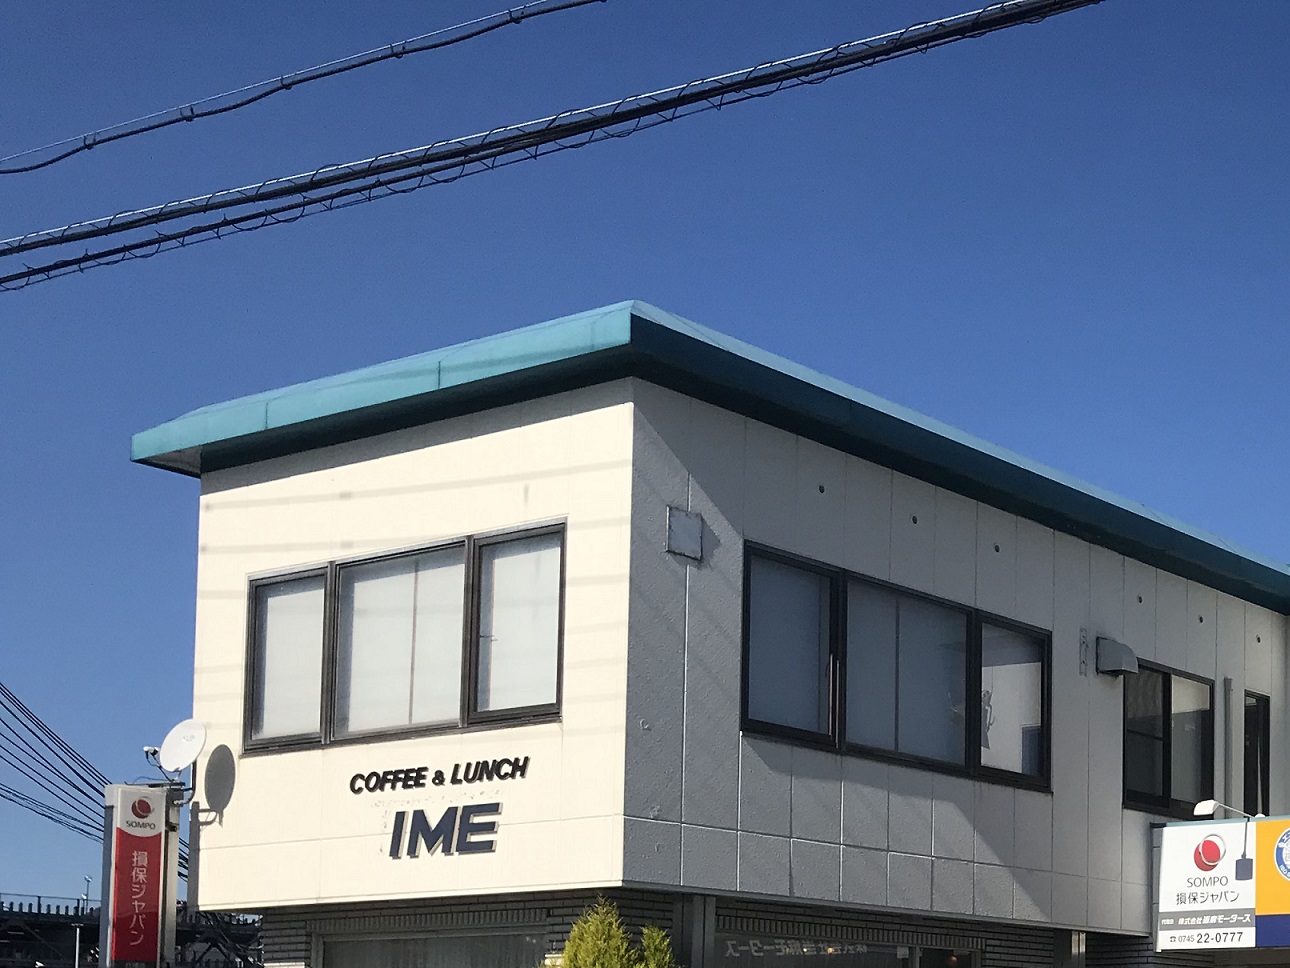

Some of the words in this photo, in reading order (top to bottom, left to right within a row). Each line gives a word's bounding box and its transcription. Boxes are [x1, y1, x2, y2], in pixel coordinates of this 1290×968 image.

[350, 766, 429, 795] COFFEE
[431, 769, 446, 786] &
[450, 756, 531, 785] LUNCH
[125, 820, 156, 830] SOMPO
[389, 802, 503, 860] IME
[1186, 876, 1229, 888] SOMPO
[130, 850, 147, 945] 損保ジャパン
[1176, 890, 1240, 905] 損保ジャパン
[1178, 935, 1194, 943] 0745
[1196, 932, 1243, 943] 22-0777
